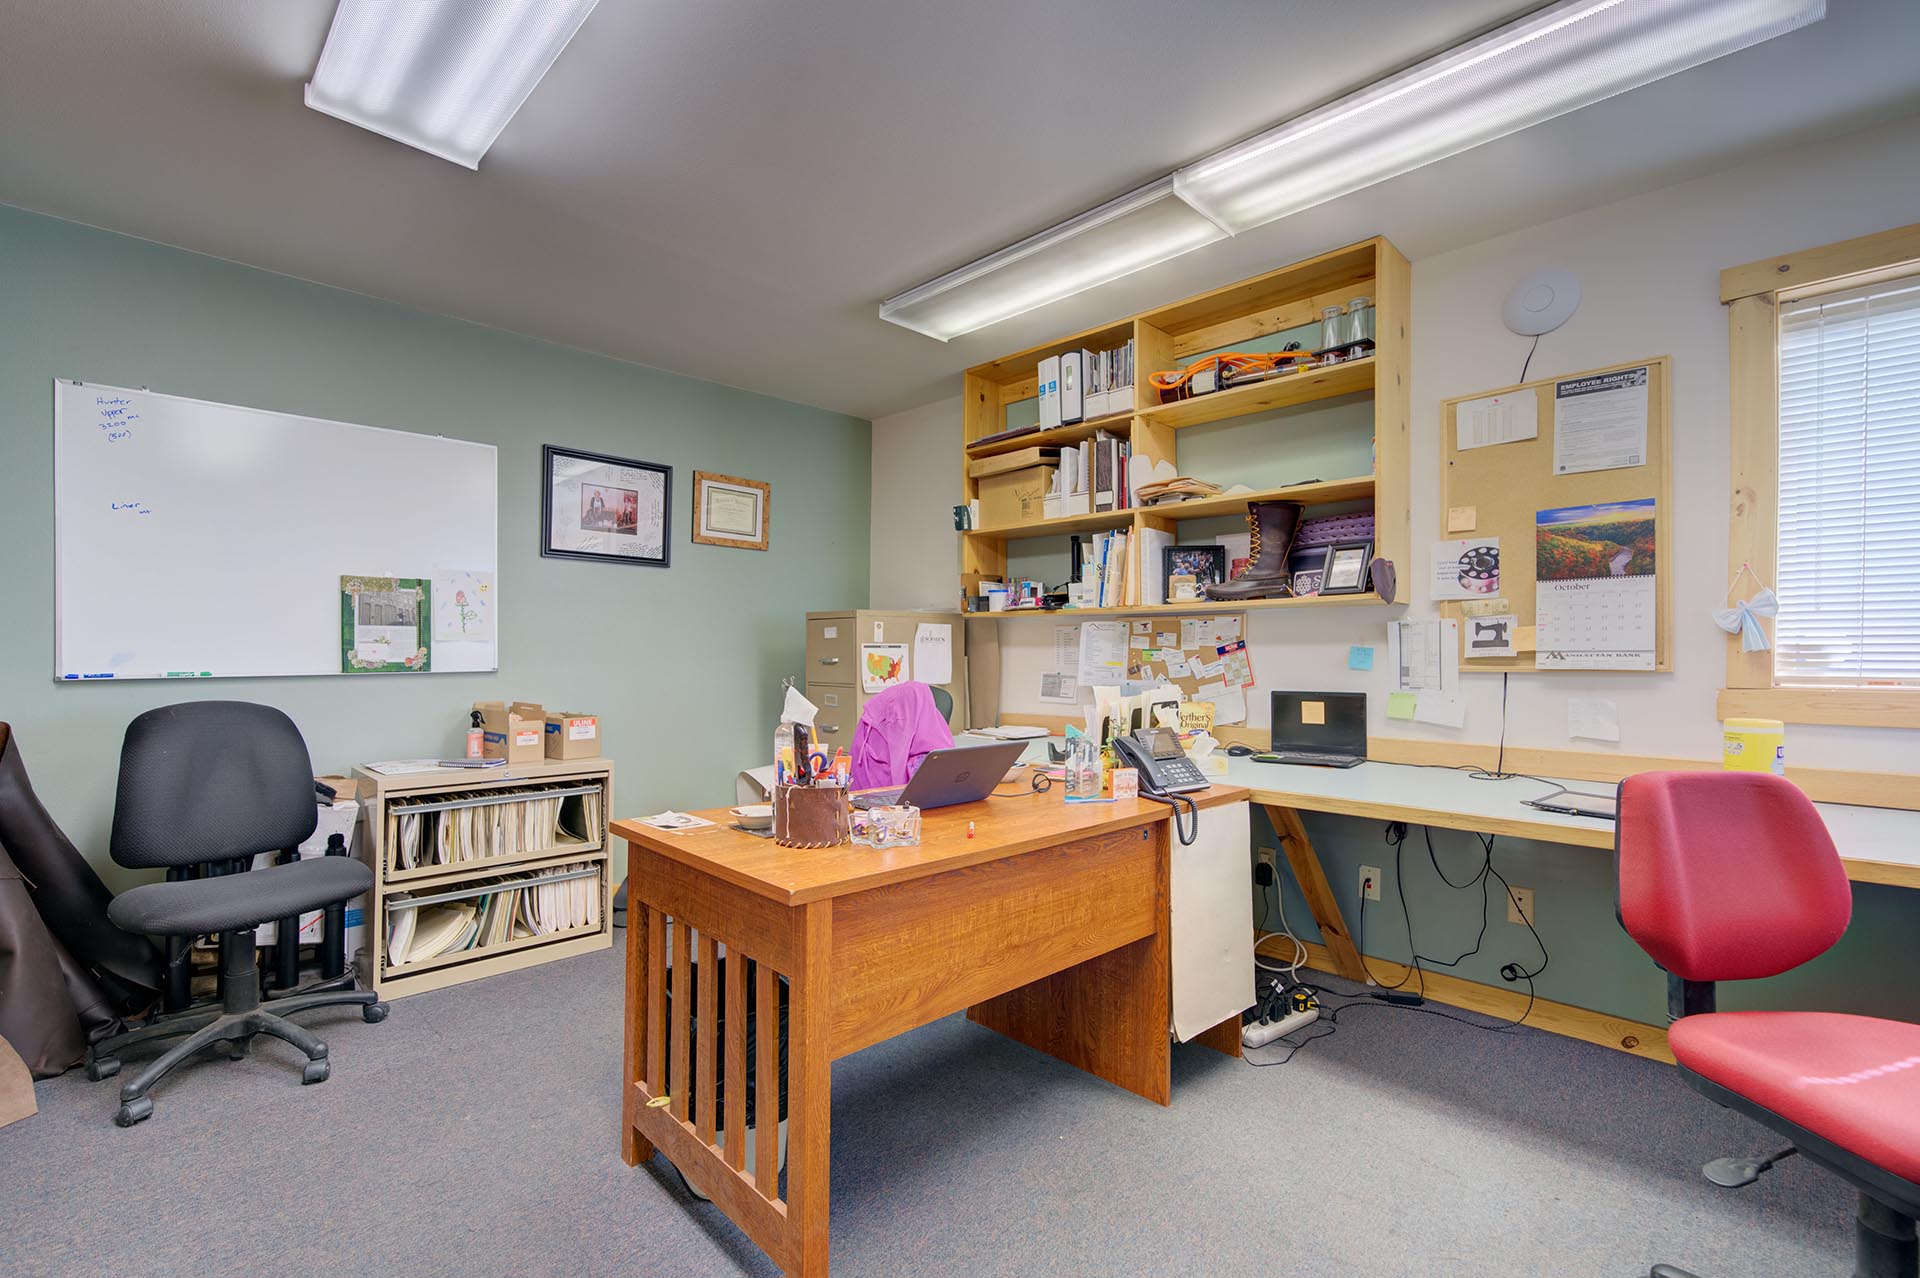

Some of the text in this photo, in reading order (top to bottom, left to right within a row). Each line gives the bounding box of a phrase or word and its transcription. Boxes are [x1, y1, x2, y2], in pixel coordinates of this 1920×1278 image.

[1560, 379, 1602, 390] EMPLOYEE
[1603, 373, 1635, 382] RIGHTS
[97, 396, 132, 405] Hunter
[101, 407, 127, 419] Upper
[99, 420, 126, 430] 3200
[1554, 583, 1591, 592] October
[1179, 711, 1211, 721] erther's
[1180, 720, 1209, 729] Original
